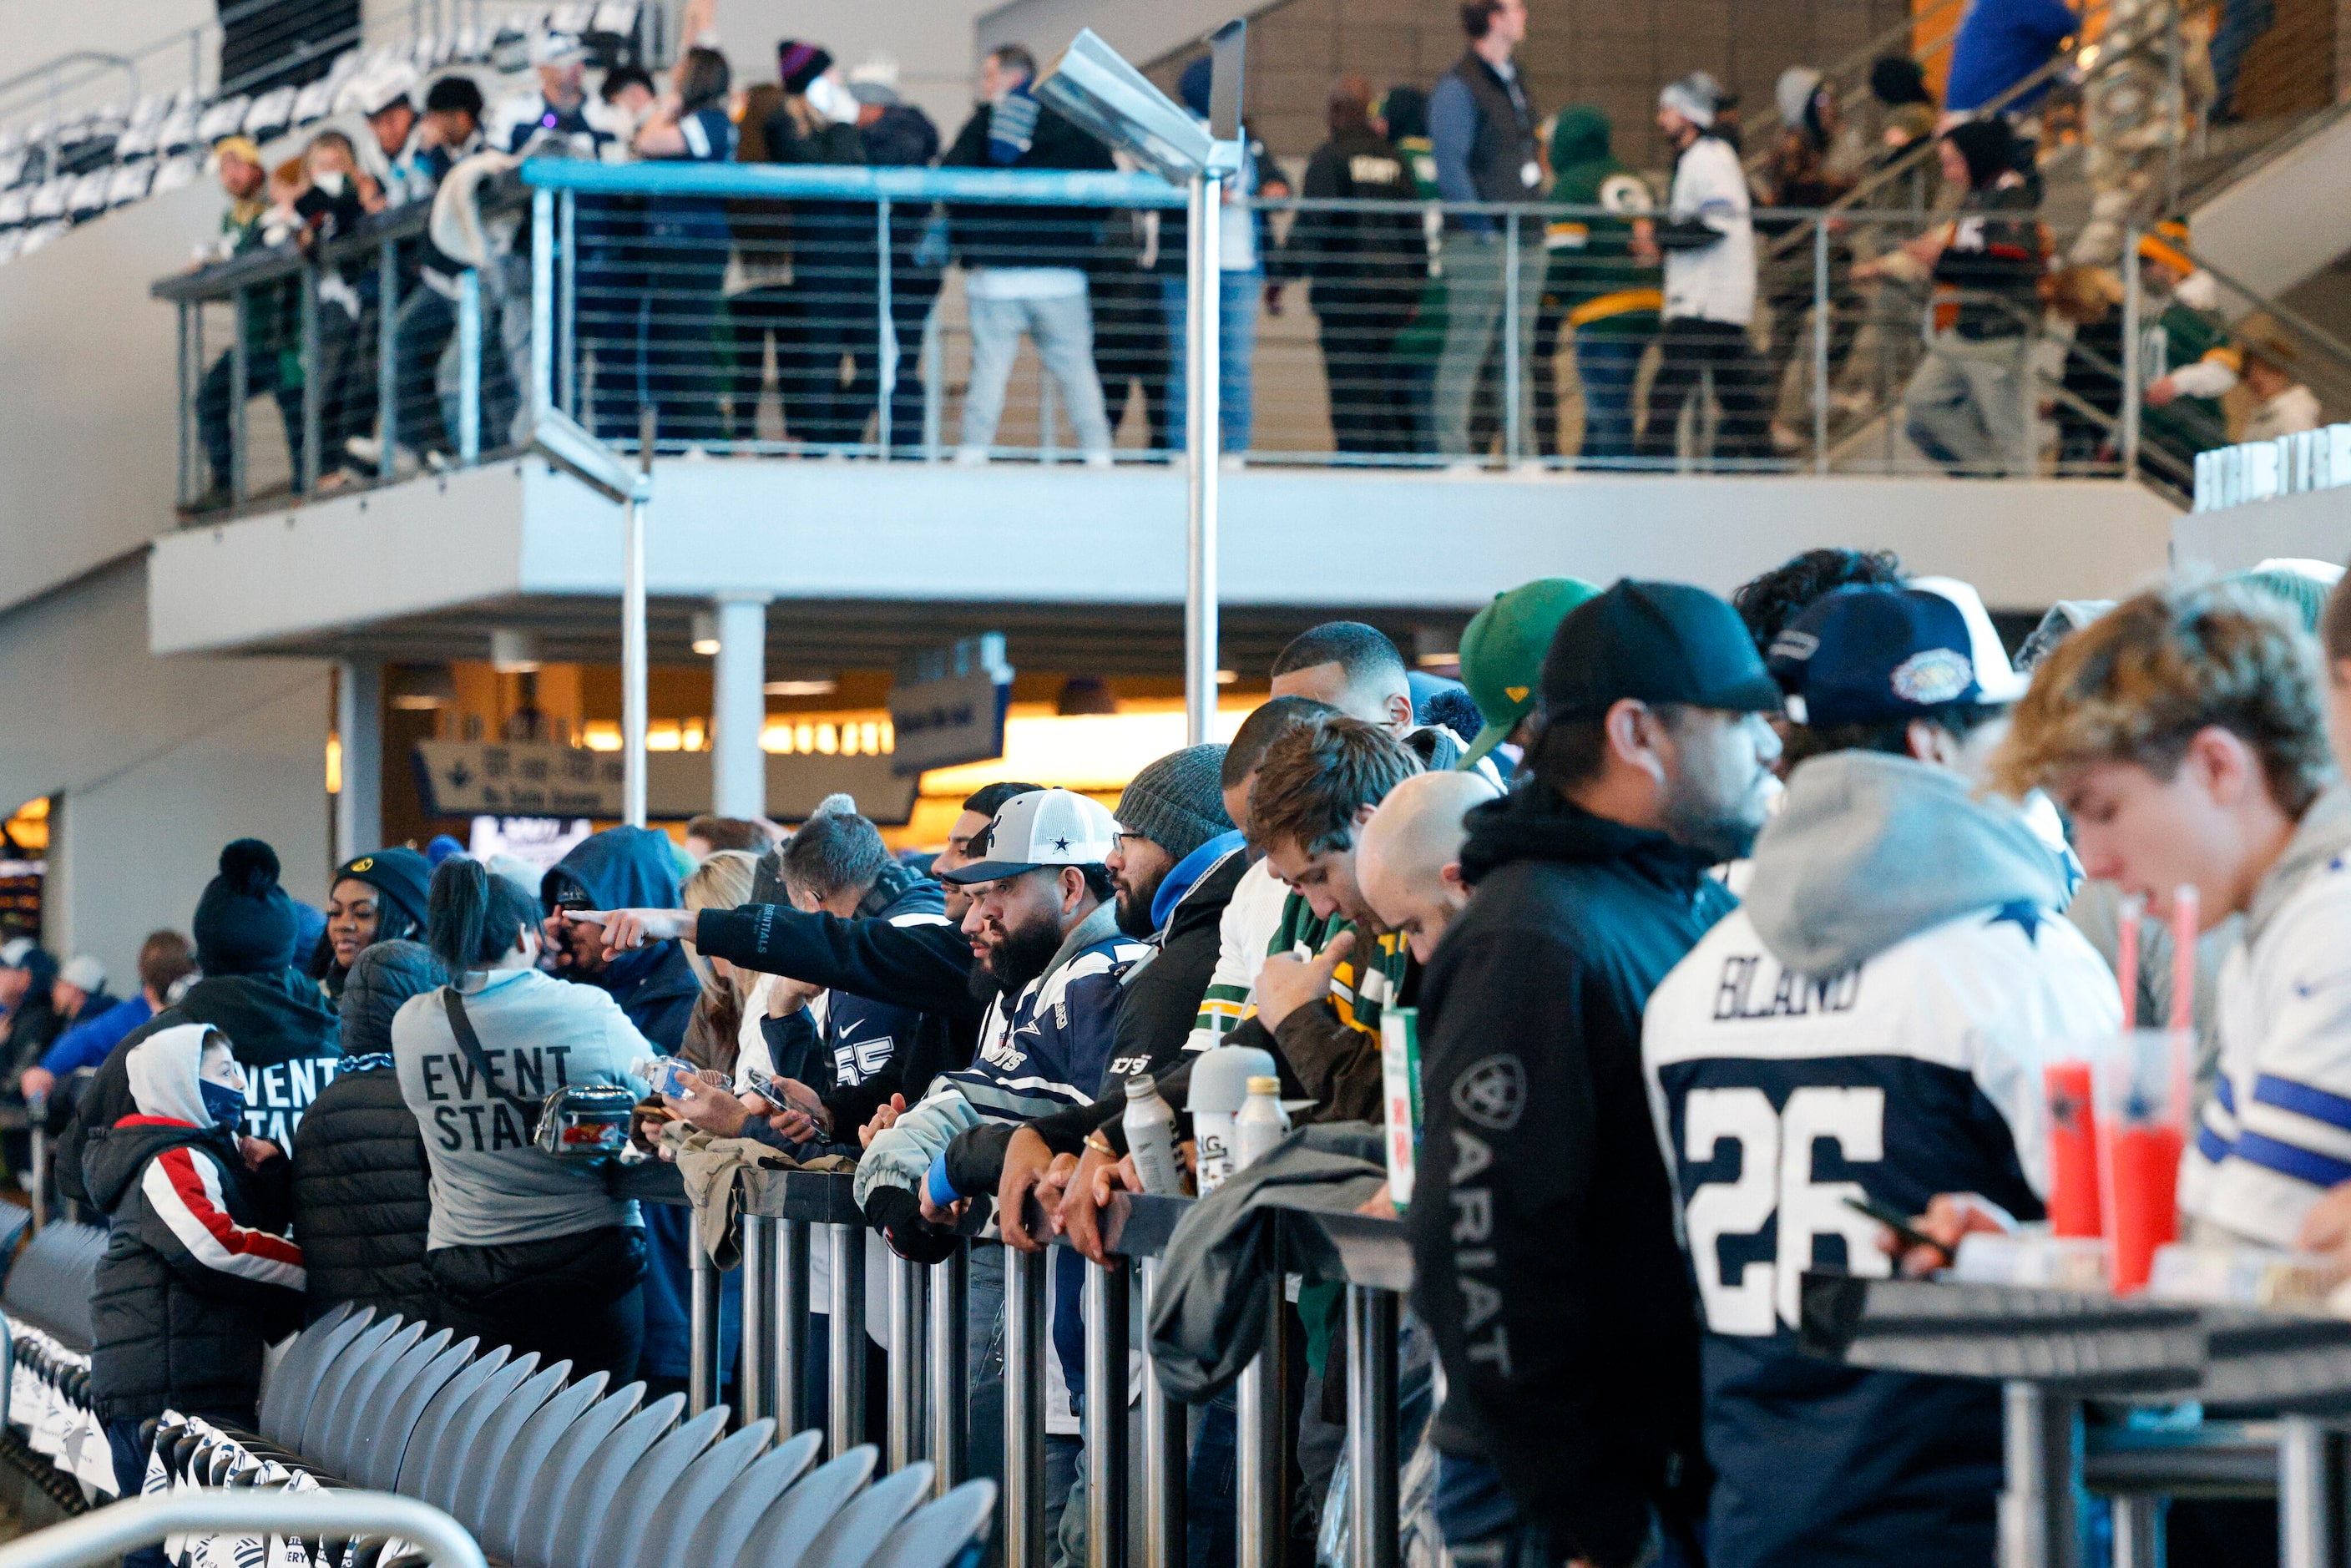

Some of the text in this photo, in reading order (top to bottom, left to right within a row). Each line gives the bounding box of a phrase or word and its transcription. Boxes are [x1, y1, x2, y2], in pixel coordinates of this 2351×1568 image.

[233, 1057, 339, 1108] VENT
[422, 1045, 571, 1101] EVENT
[833, 1035, 895, 1087] 55
[1685, 1086, 1893, 1336] 26
[1449, 1126, 1514, 1379] ARIAT
